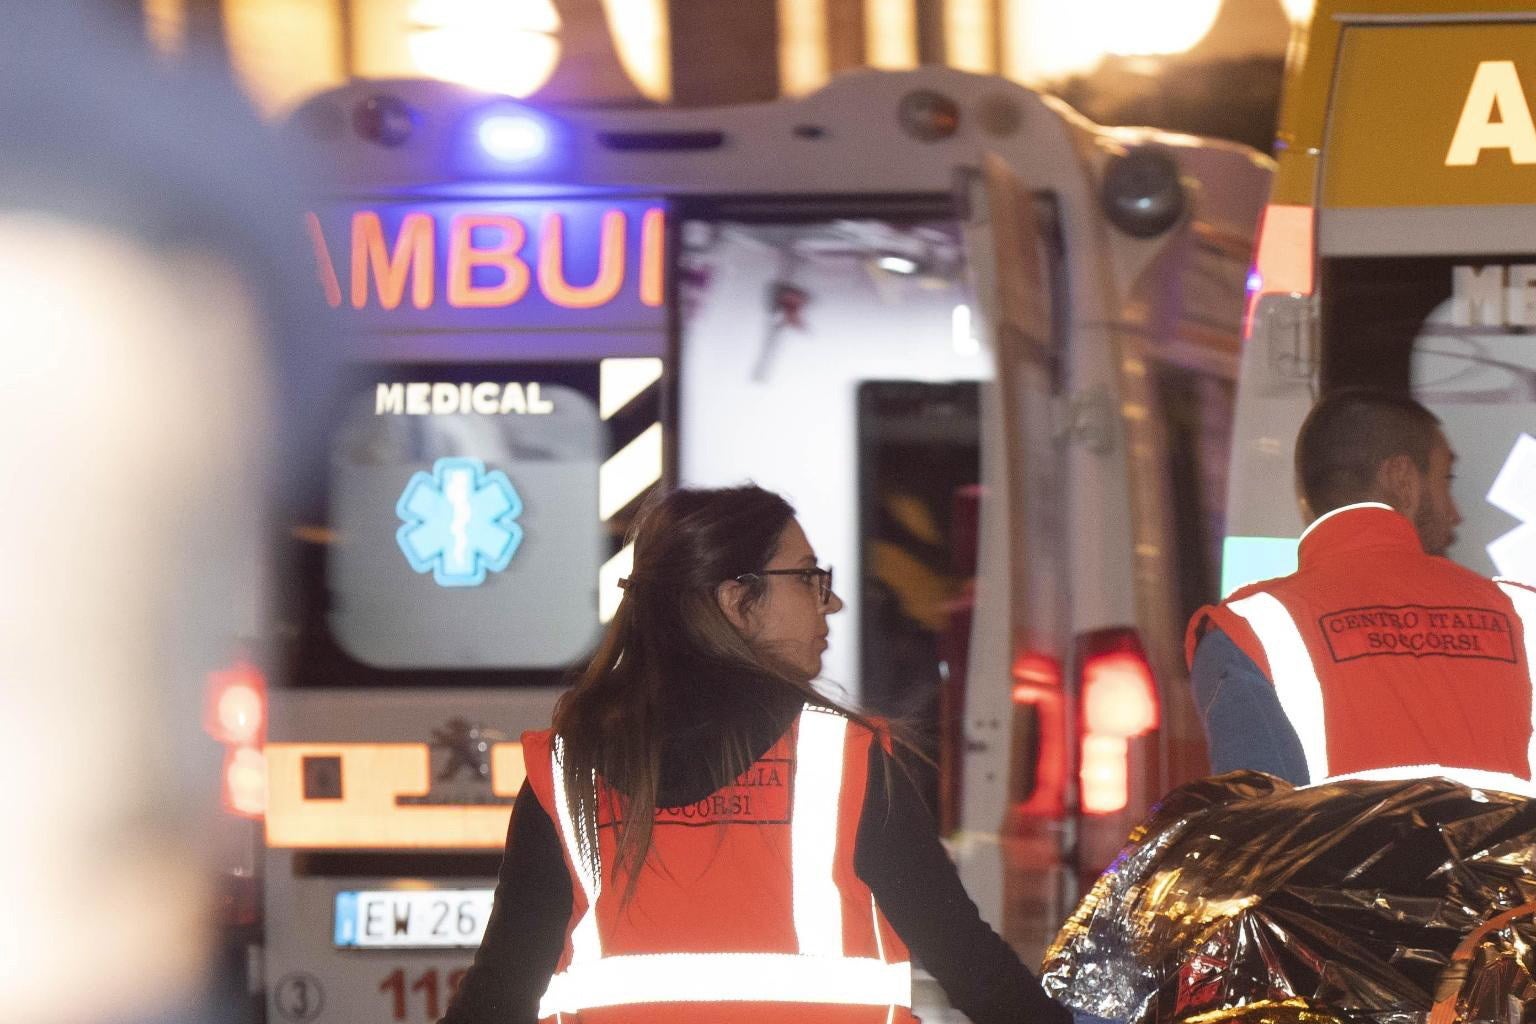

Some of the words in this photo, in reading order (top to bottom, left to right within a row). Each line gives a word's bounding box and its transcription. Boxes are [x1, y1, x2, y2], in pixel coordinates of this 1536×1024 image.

[374, 382, 553, 416] MEDICAL
[1329, 612, 1420, 634] CENTRO
[1427, 613, 1505, 633] ITALIA
[1367, 631, 1482, 651] SOCCORSI
[364, 900, 412, 937] EW
[430, 900, 495, 937] 26
